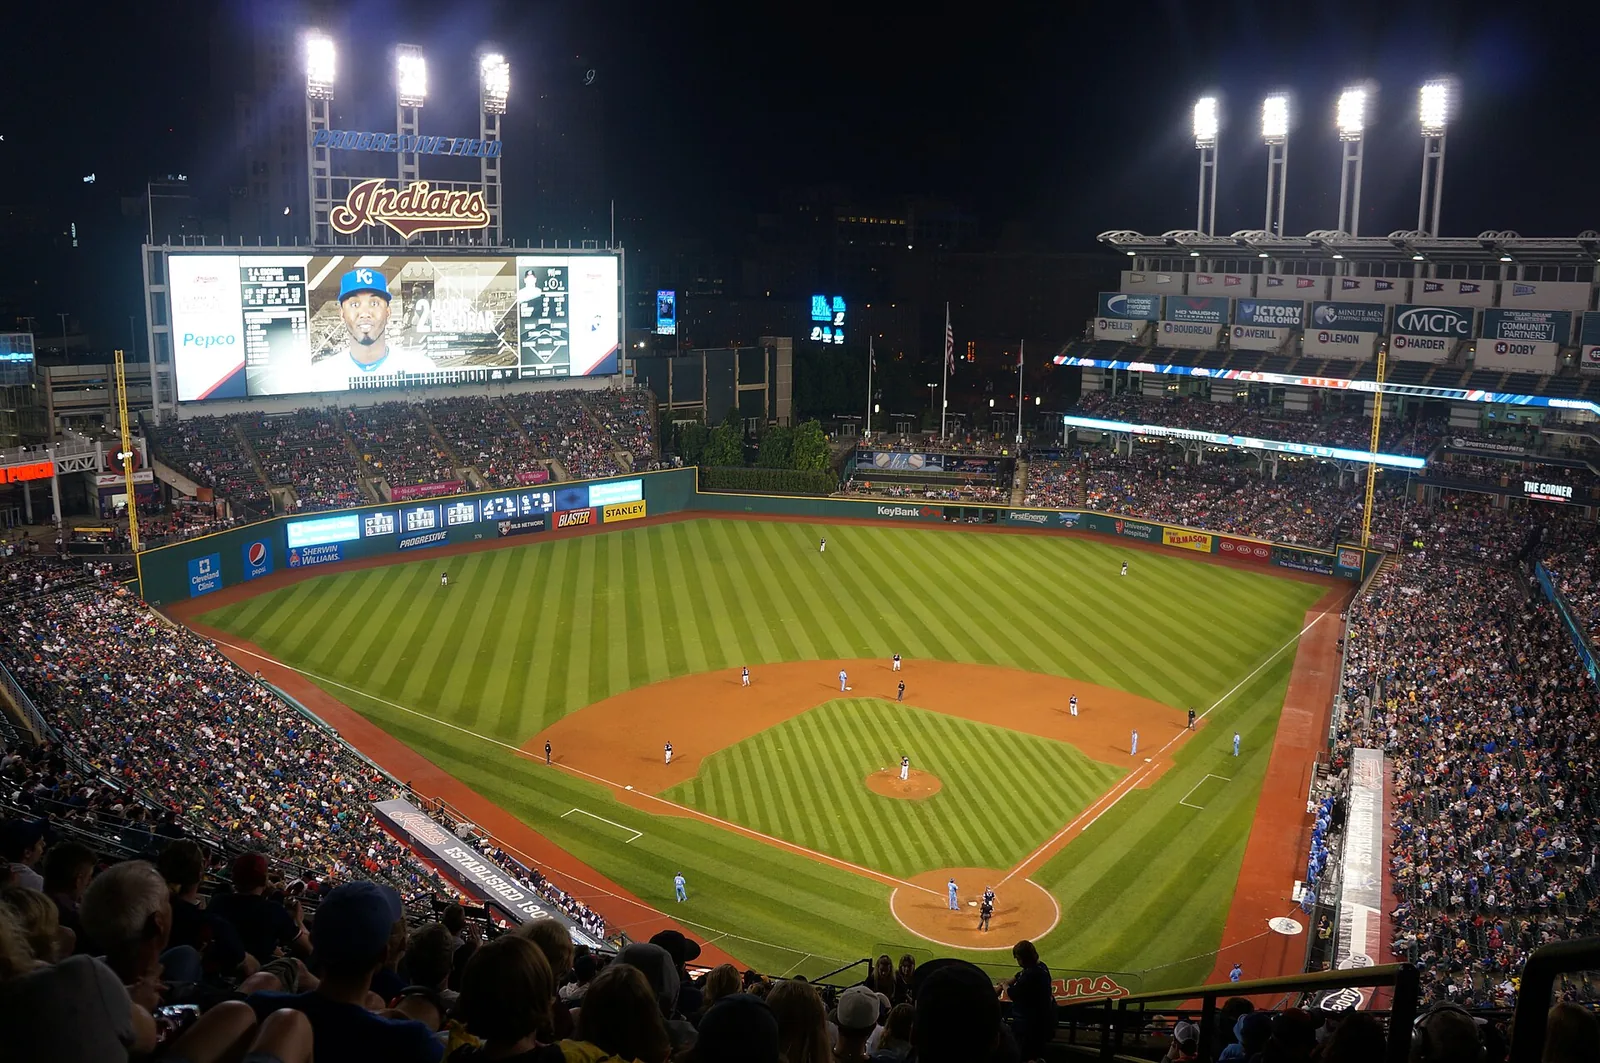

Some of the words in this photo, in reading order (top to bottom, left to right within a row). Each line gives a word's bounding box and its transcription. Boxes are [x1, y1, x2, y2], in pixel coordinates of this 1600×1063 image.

[312, 129, 447, 155] PROGRESSIVE
[449, 137, 502, 158] FIELD
[330, 178, 490, 239] Indians
[356, 268, 373, 285] KC
[1253, 315, 1275, 323] PARK
[1276, 316, 1300, 324] OHIO
[1108, 322, 1133, 330] FELLER
[1173, 324, 1213, 335] BOUDREAU
[1502, 323, 1551, 332] COMMUNITY
[1244, 329, 1276, 339] AVERILL
[1330, 333, 1359, 344] LEMON
[1504, 330, 1547, 340] PARTNERS
[183, 333, 236, 348] Pepco
[1407, 338, 1445, 350] HARDER
[1509, 344, 1536, 355] DOBY
[1524, 481, 1539, 493] THE
[1540, 483, 1573, 498] CORNER
[606, 505, 644, 518] STANLEY
[877, 506, 920, 517] KeyBank
[558, 511, 591, 528] BLASTER
[1010, 512, 1048, 523] FirstEnergy
[521, 520, 544, 528] NETWORK
[1124, 522, 1152, 533] University
[1123, 529, 1149, 538] Hospitals
[400, 531, 448, 549] PROGRESSIVE
[303, 545, 338, 557] SHERWIN
[1341, 550, 1358, 562] drug
[1288, 562, 1308, 571] University
[1341, 559, 1360, 568] mart
[252, 566, 266, 576] pepsi
[191, 570, 219, 585] Cleveland
[198, 580, 214, 592] Clinic
[389, 811, 448, 846] Indians
[444, 846, 525, 902] ESTABLISHED
[516, 900, 554, 920] 190
